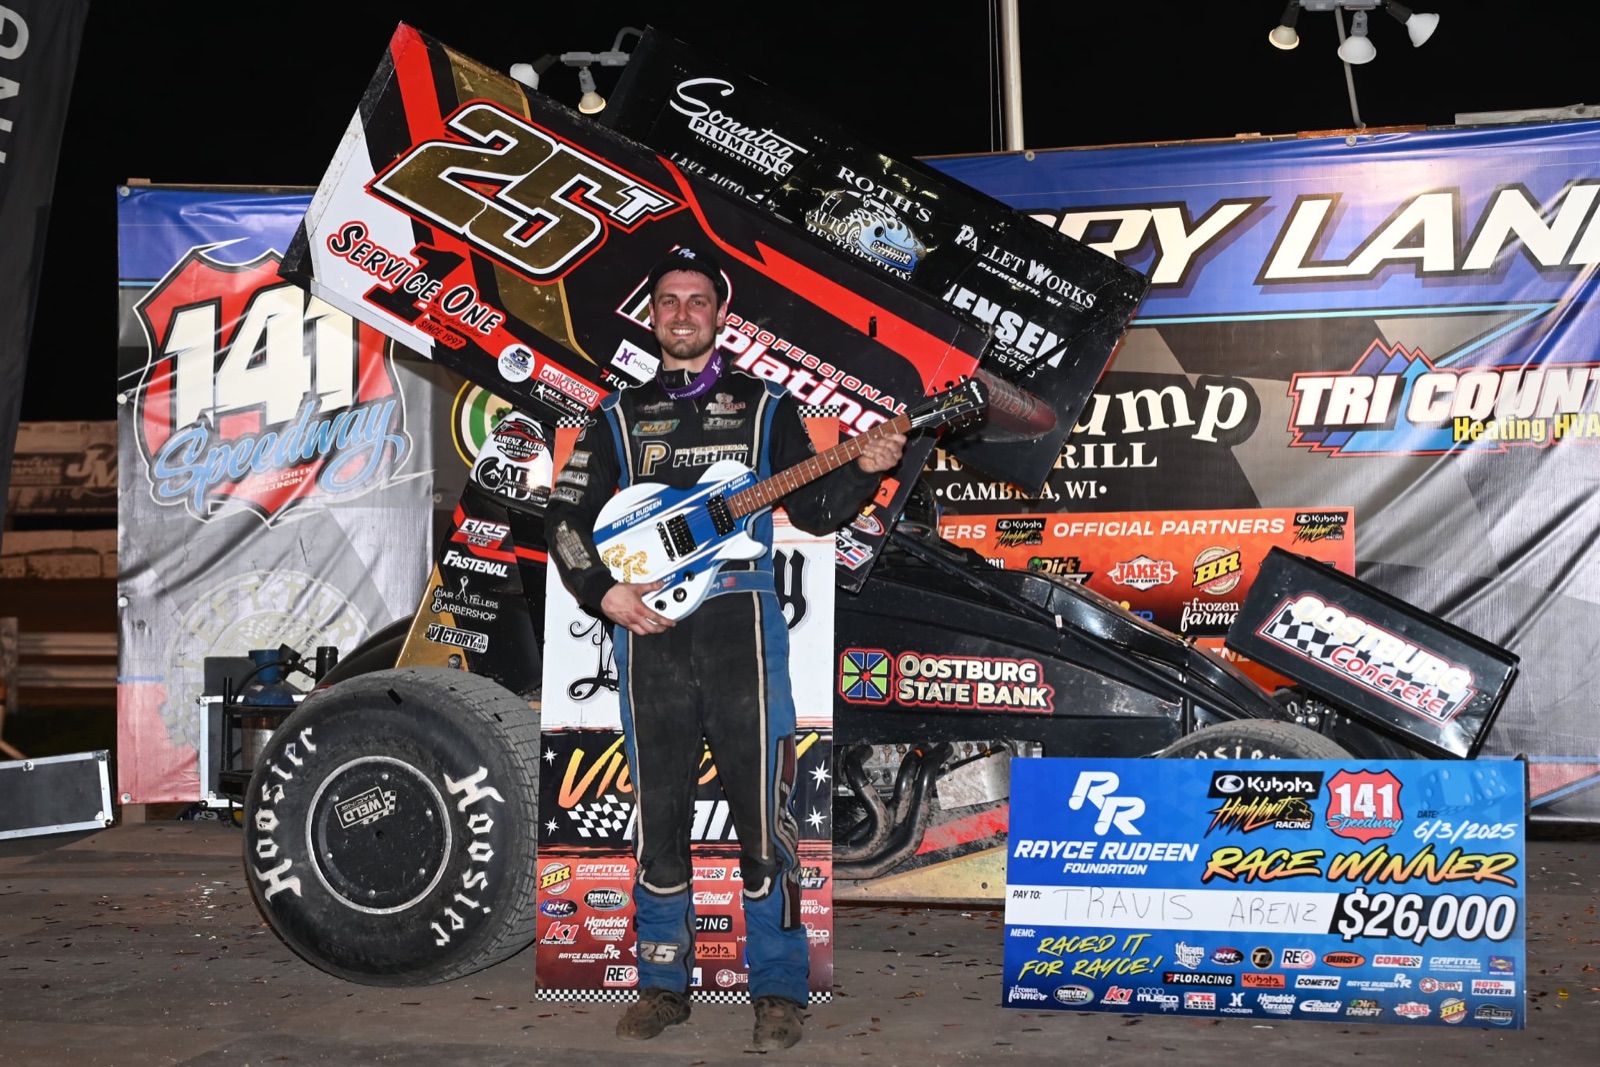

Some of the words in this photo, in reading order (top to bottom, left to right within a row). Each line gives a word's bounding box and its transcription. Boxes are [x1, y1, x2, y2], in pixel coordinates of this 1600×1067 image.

[670, 78, 808, 161] Sonntag
[689, 117, 793, 176] PLUMBING
[695, 134, 766, 175] INCORPORATED
[836, 165, 933, 223] ROTH'S
[809, 208, 848, 236] AUTO
[1031, 203, 1252, 284] RY
[331, 225, 444, 301] SERVICE
[441, 285, 503, 335] ONE
[977, 261, 1042, 298] PLYMOUTH,
[1045, 295, 1063, 308] WI
[1027, 258, 1098, 309] WORKS
[418, 320, 444, 338] SINCE
[442, 332, 464, 348] 1997
[163, 284, 353, 430] 141
[724, 312, 909, 415] PROFESSIONAL
[994, 339, 1045, 371] Servie
[570, 379, 596, 397] RACING
[676, 383, 706, 399] HOOSIER
[714, 325, 892, 438] Plating
[566, 399, 586, 412] TAR
[1294, 373, 1398, 426] TRI
[1072, 383, 1249, 443] ump
[1453, 417, 1546, 442] Heating
[1554, 413, 1600, 440] HVA
[496, 434, 522, 446] ARENZ
[523, 440, 545, 451] AUTO
[155, 399, 406, 512] Speedway
[672, 450, 748, 468] Plating
[1053, 441, 1158, 469] RILL
[945, 482, 1059, 501] CAMBA,
[1064, 481, 1099, 498] WI
[611, 511, 635, 530] RAYCE
[635, 499, 663, 518] RUDEEN
[1012, 519, 1043, 530] Kubota
[1311, 514, 1346, 523] Kubota
[937, 524, 987, 540] ERS
[1053, 521, 1155, 537] OFFICIAL
[1160, 518, 1286, 536] PARTNERS
[443, 550, 509, 578] FASTENAL
[1039, 559, 1077, 574] Dirt
[1112, 561, 1173, 581] JAKE'S
[434, 587, 454, 600] HAIR
[431, 599, 497, 622] BARBERSHOP
[1191, 597, 1240, 612] frozen
[1180, 606, 1239, 633] farme
[427, 624, 477, 648] VICTORY
[1290, 595, 1474, 693] OOSTBURG
[899, 654, 1037, 683] OOSTBURG
[1330, 646, 1447, 714] Concrete
[898, 678, 971, 702] STATE
[977, 682, 1048, 707] BANK
[1247, 776, 1315, 793] Kubota
[1334, 782, 1395, 818] 141
[342, 798, 383, 823] WELD
[1416, 810, 1439, 819] DATE:
[1275, 820, 1311, 830] RACING
[1326, 813, 1404, 836] Speedway
[1413, 820, 1519, 844] 6/3/2025
[1013, 839, 1098, 860] RAYCE
[1100, 841, 1200, 862] RUDEEN
[576, 864, 630, 873] CAPITOL
[1062, 862, 1148, 875] FOUNDATION
[1201, 846, 1325, 884] RACE
[1325, 843, 1518, 887] WINNER
[587, 892, 623, 900] DRIVEN
[1012, 889, 1028, 900] PAY
[1029, 889, 1042, 900] TO:
[1052, 886, 1194, 922] TRAVIS
[1228, 895, 1319, 929] ARENZ
[1336, 887, 1518, 943] $26,000
[544, 920, 580, 941] K1
[584, 916, 630, 930] Hendrick
[1010, 927, 1036, 938] MEMO:
[590, 927, 626, 940] Cars.com
[639, 942, 680, 965] 25
[1037, 933, 1118, 957] RACED
[1121, 932, 1153, 957] IT
[558, 952, 582, 960] RAYCE
[582, 953, 609, 961] RUDEEN
[1214, 951, 1237, 961] DMI
[1326, 955, 1360, 964] DURST
[1374, 956, 1411, 966] COMP
[1429, 956, 1482, 966] CAPITOL
[1017, 959, 1065, 982] FOR
[1071, 955, 1164, 981] RAYCE!
[1015, 984, 1039, 993] frozen
[1243, 974, 1280, 985] Kubota
[1297, 978, 1339, 988] COMETIC
[1346, 980, 1368, 988] RAYCE
[1370, 980, 1400, 989] RUDEEN
[1437, 982, 1463, 992] SUPPLY
[1008, 989, 1049, 1004] farmer
[1056, 988, 1088, 997] DRIVEN
[1104, 985, 1134, 1001] K1
[1257, 992, 1297, 1006] Hendrick
[1472, 987, 1513, 996] ROOTER
[1299, 999, 1342, 1013] Eibach
[1346, 1006, 1384, 1017] DRAFT
